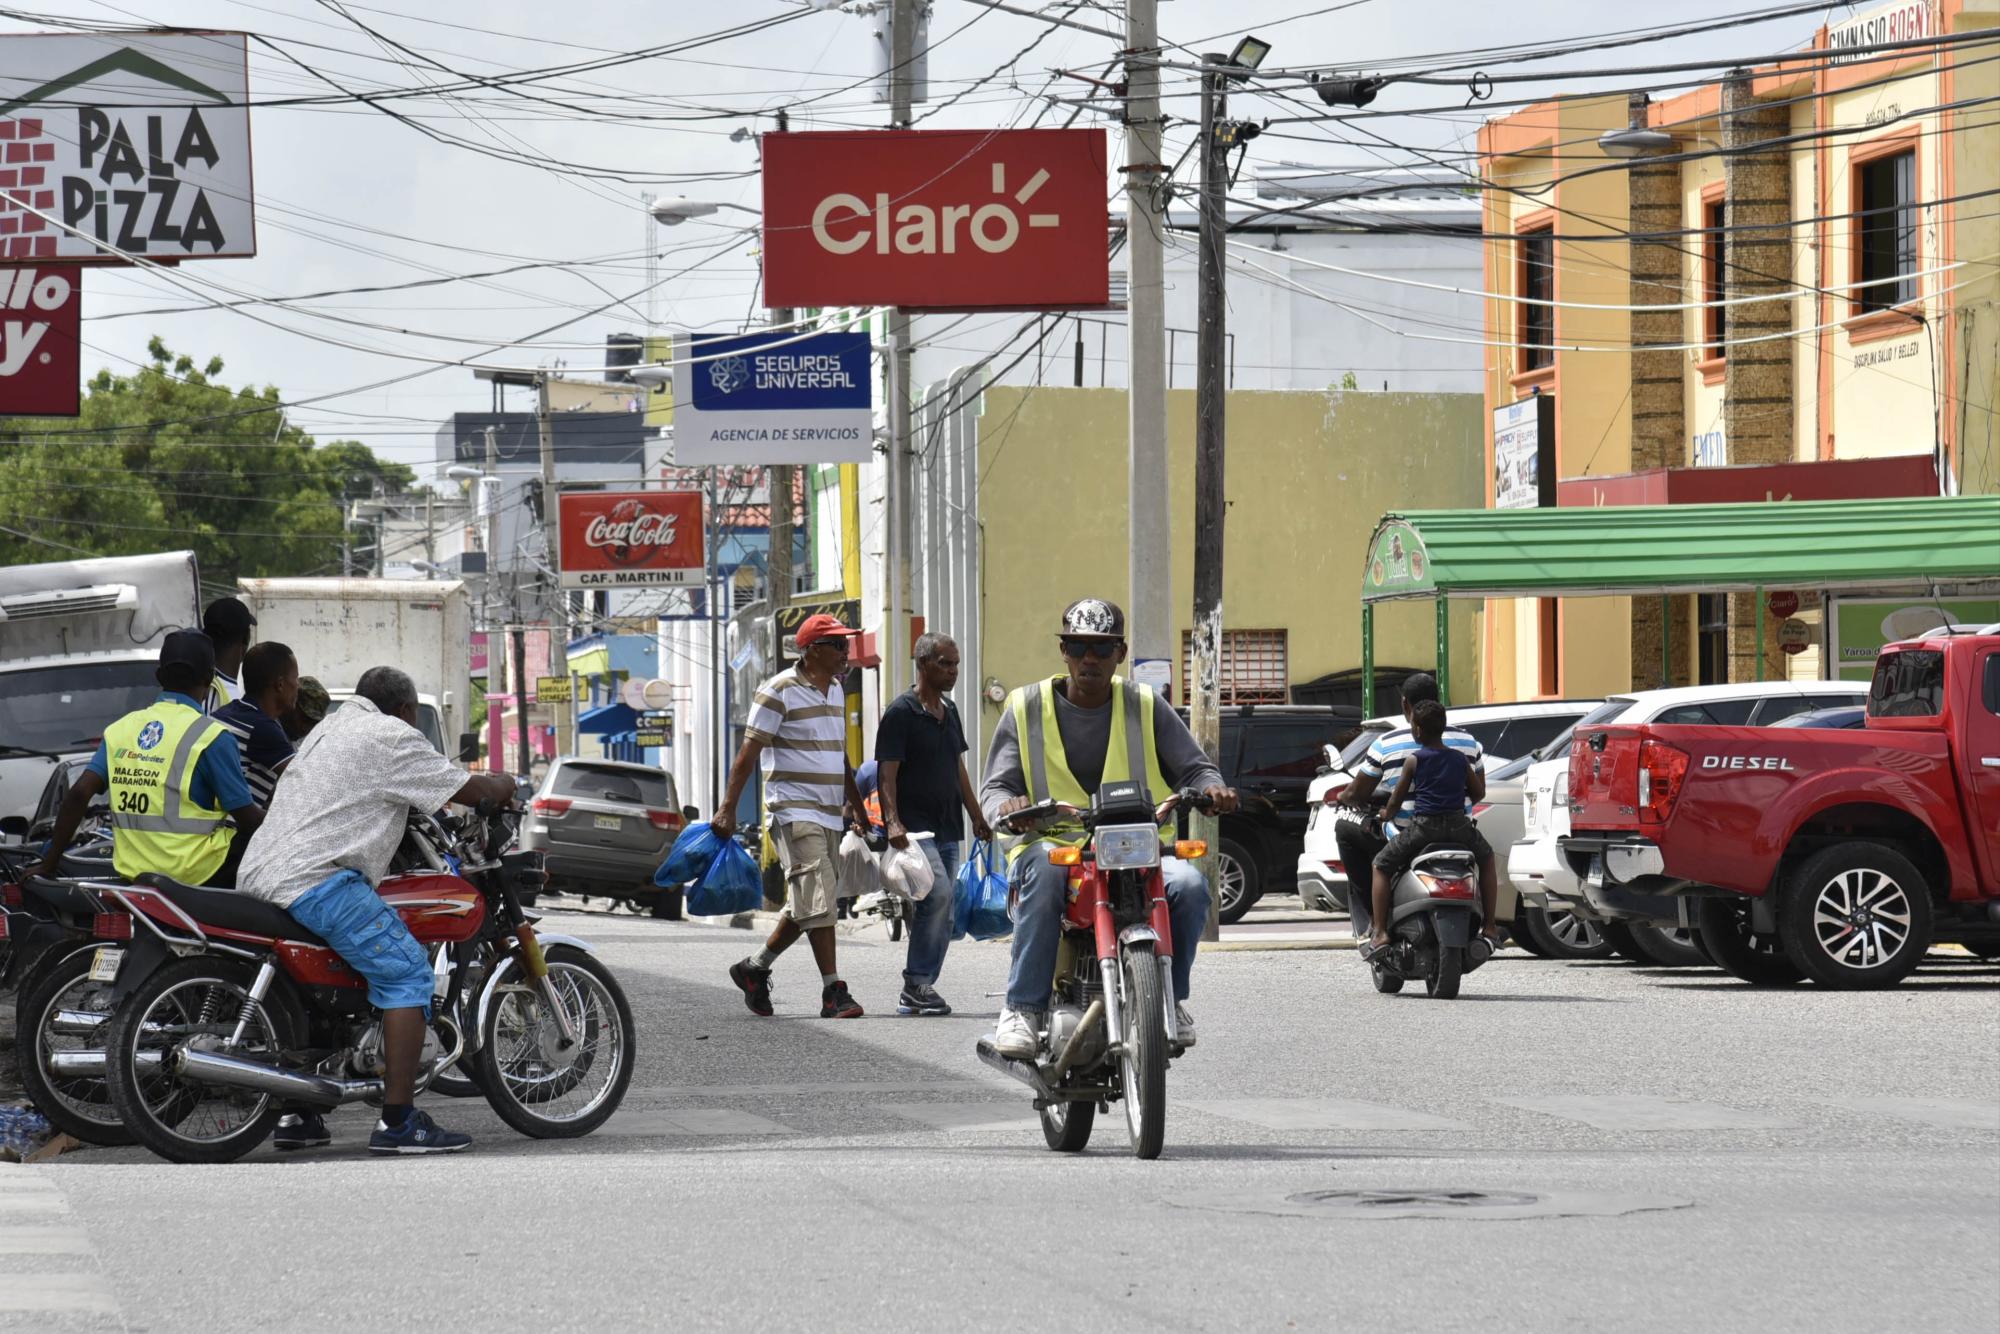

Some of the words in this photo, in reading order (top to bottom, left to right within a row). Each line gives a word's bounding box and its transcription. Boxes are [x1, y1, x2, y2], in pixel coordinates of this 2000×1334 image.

[78, 104, 220, 185] PALA
[811, 192, 1020, 255] Claro
[755, 354, 841, 372] SEGUROS
[710, 429, 769, 442] AGENCIA
[772, 428, 789, 441] DE
[791, 427, 860, 441] SERVICIOS
[580, 573, 613, 585] CAF.
[615, 572, 670, 584] MARTIN
[1844, 646, 1872, 657] Yaroa
[1702, 755, 1795, 771] DIESEL
[114, 766, 160, 778] MALECON
[111, 776, 158, 788] BARAHONA
[118, 790, 149, 815] 340
